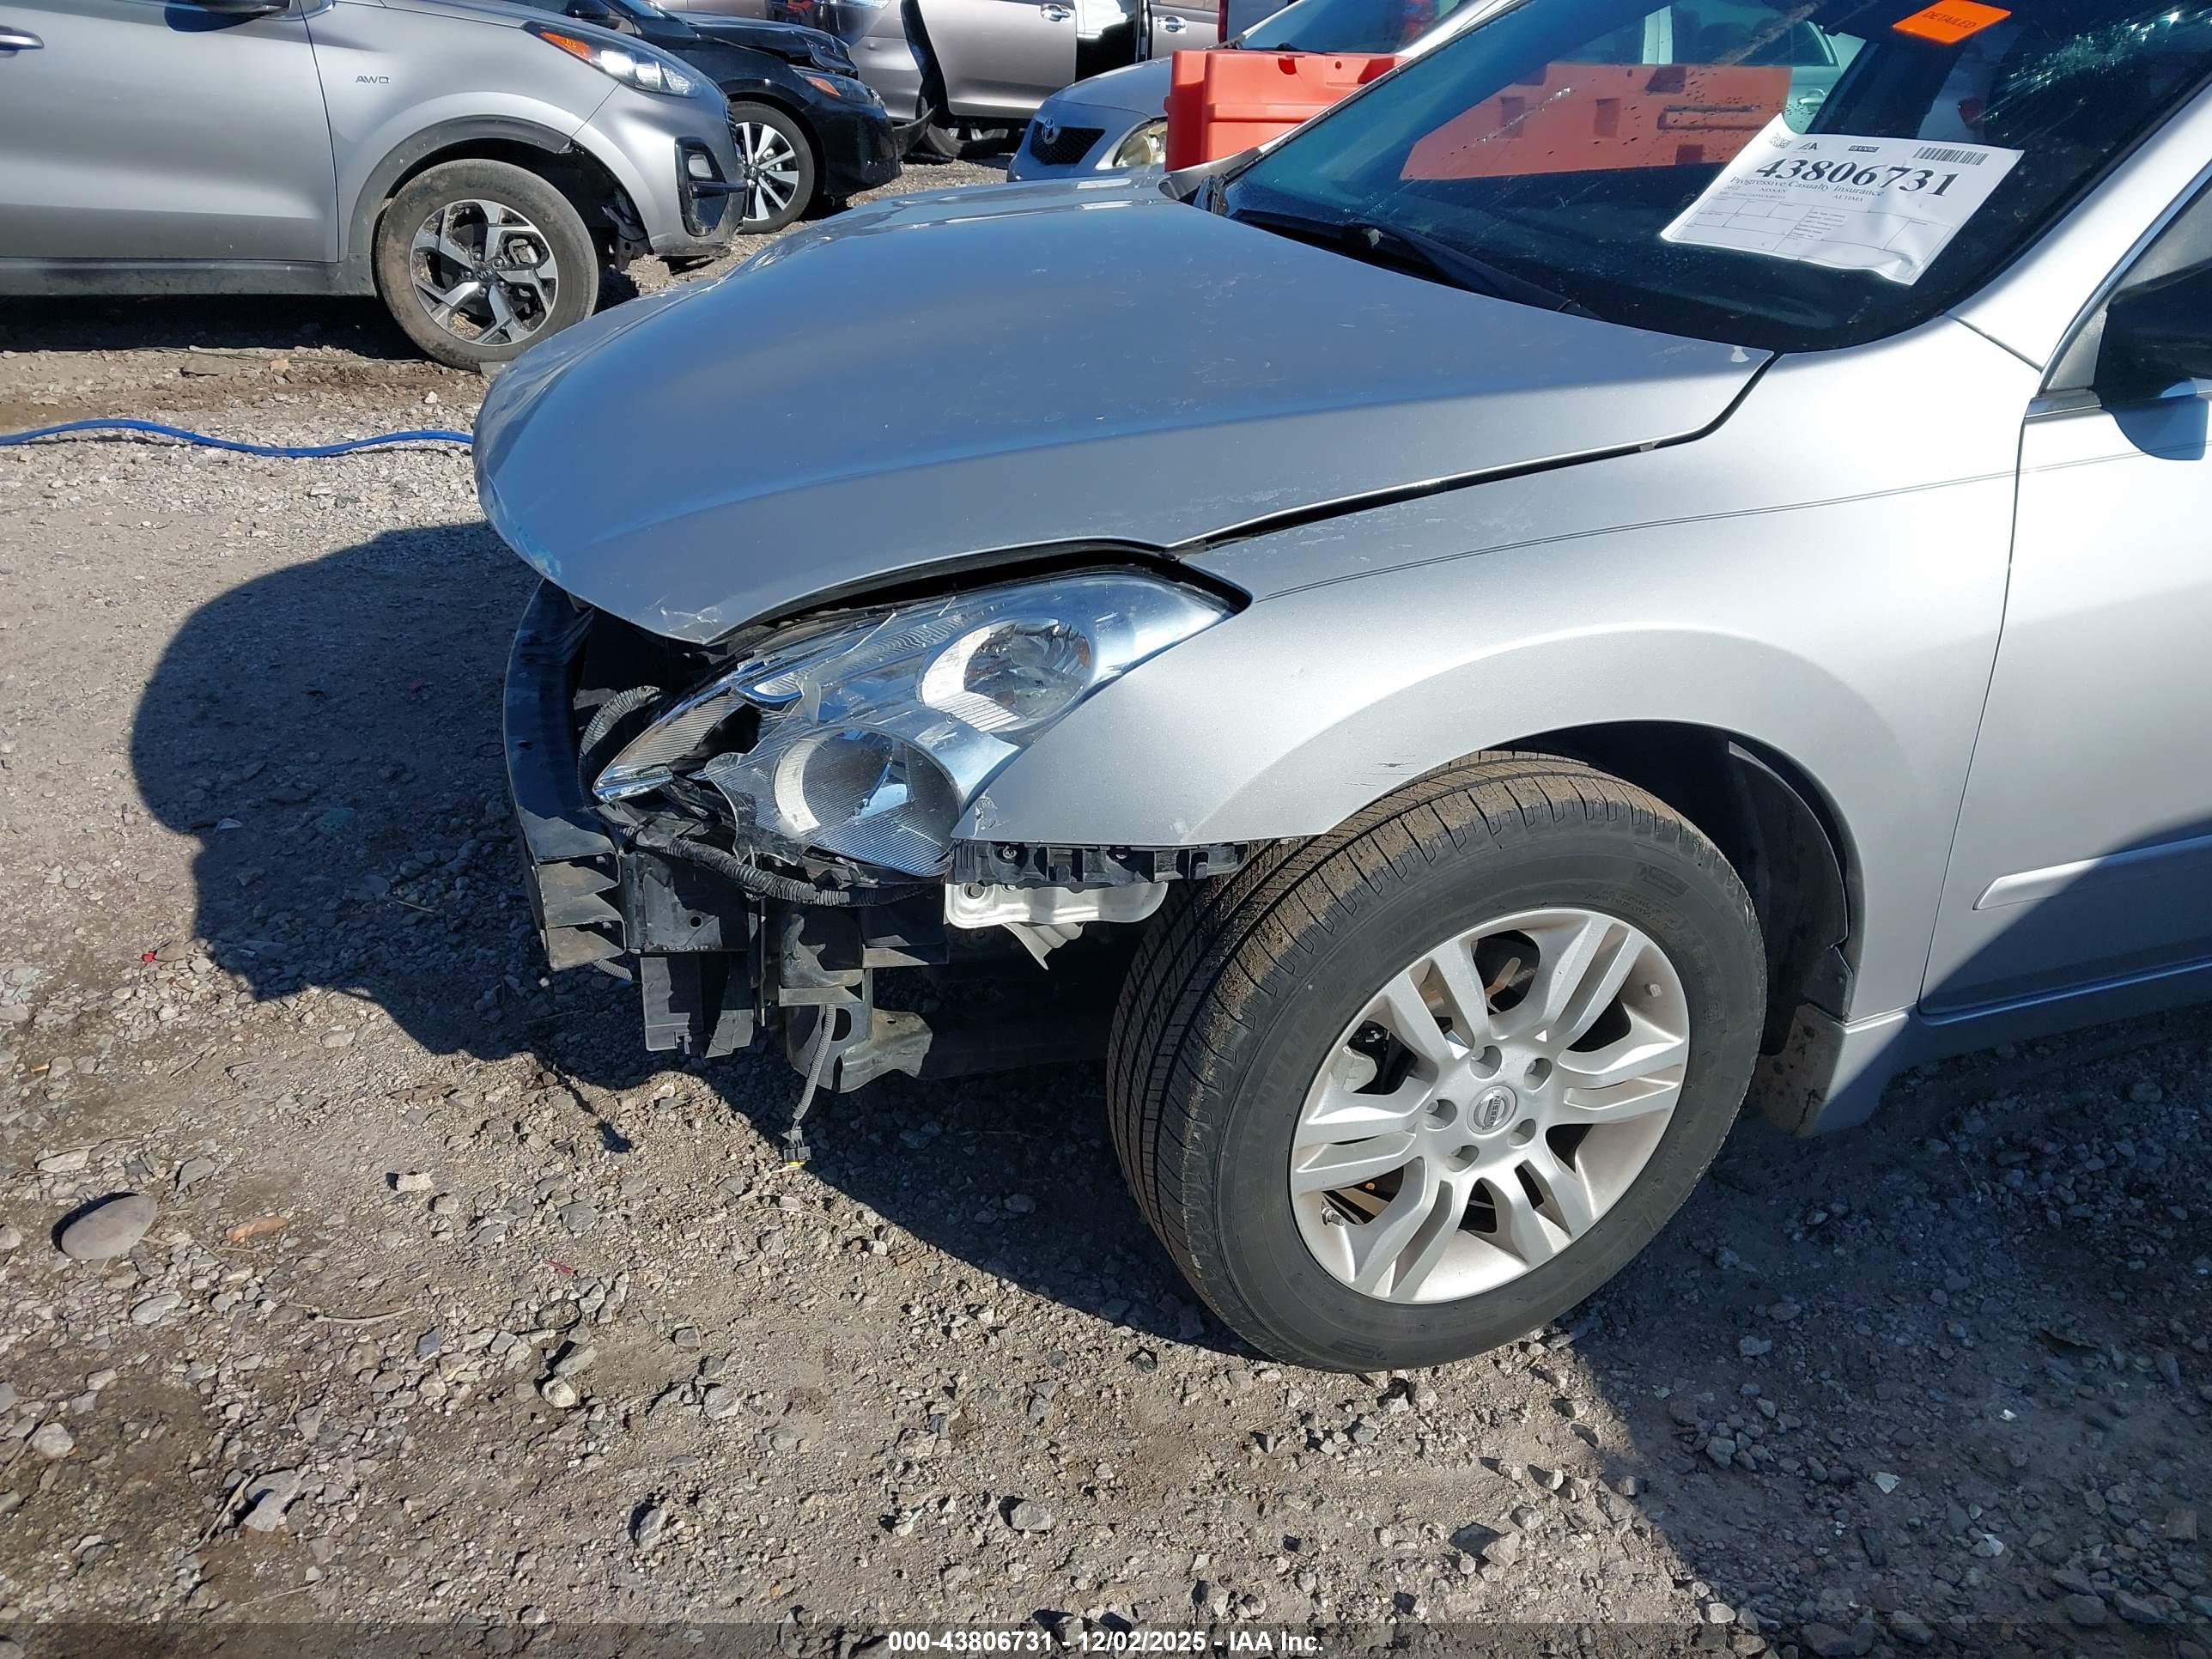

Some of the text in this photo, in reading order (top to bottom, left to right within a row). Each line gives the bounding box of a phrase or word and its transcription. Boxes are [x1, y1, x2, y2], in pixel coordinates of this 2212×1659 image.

[1922, 10, 1977, 28] DETAILED
[355, 75, 390, 84] AWD
[1730, 176, 1885, 197] Progressive Casualty Insurance
[1755, 158, 1959, 197] 43806731
